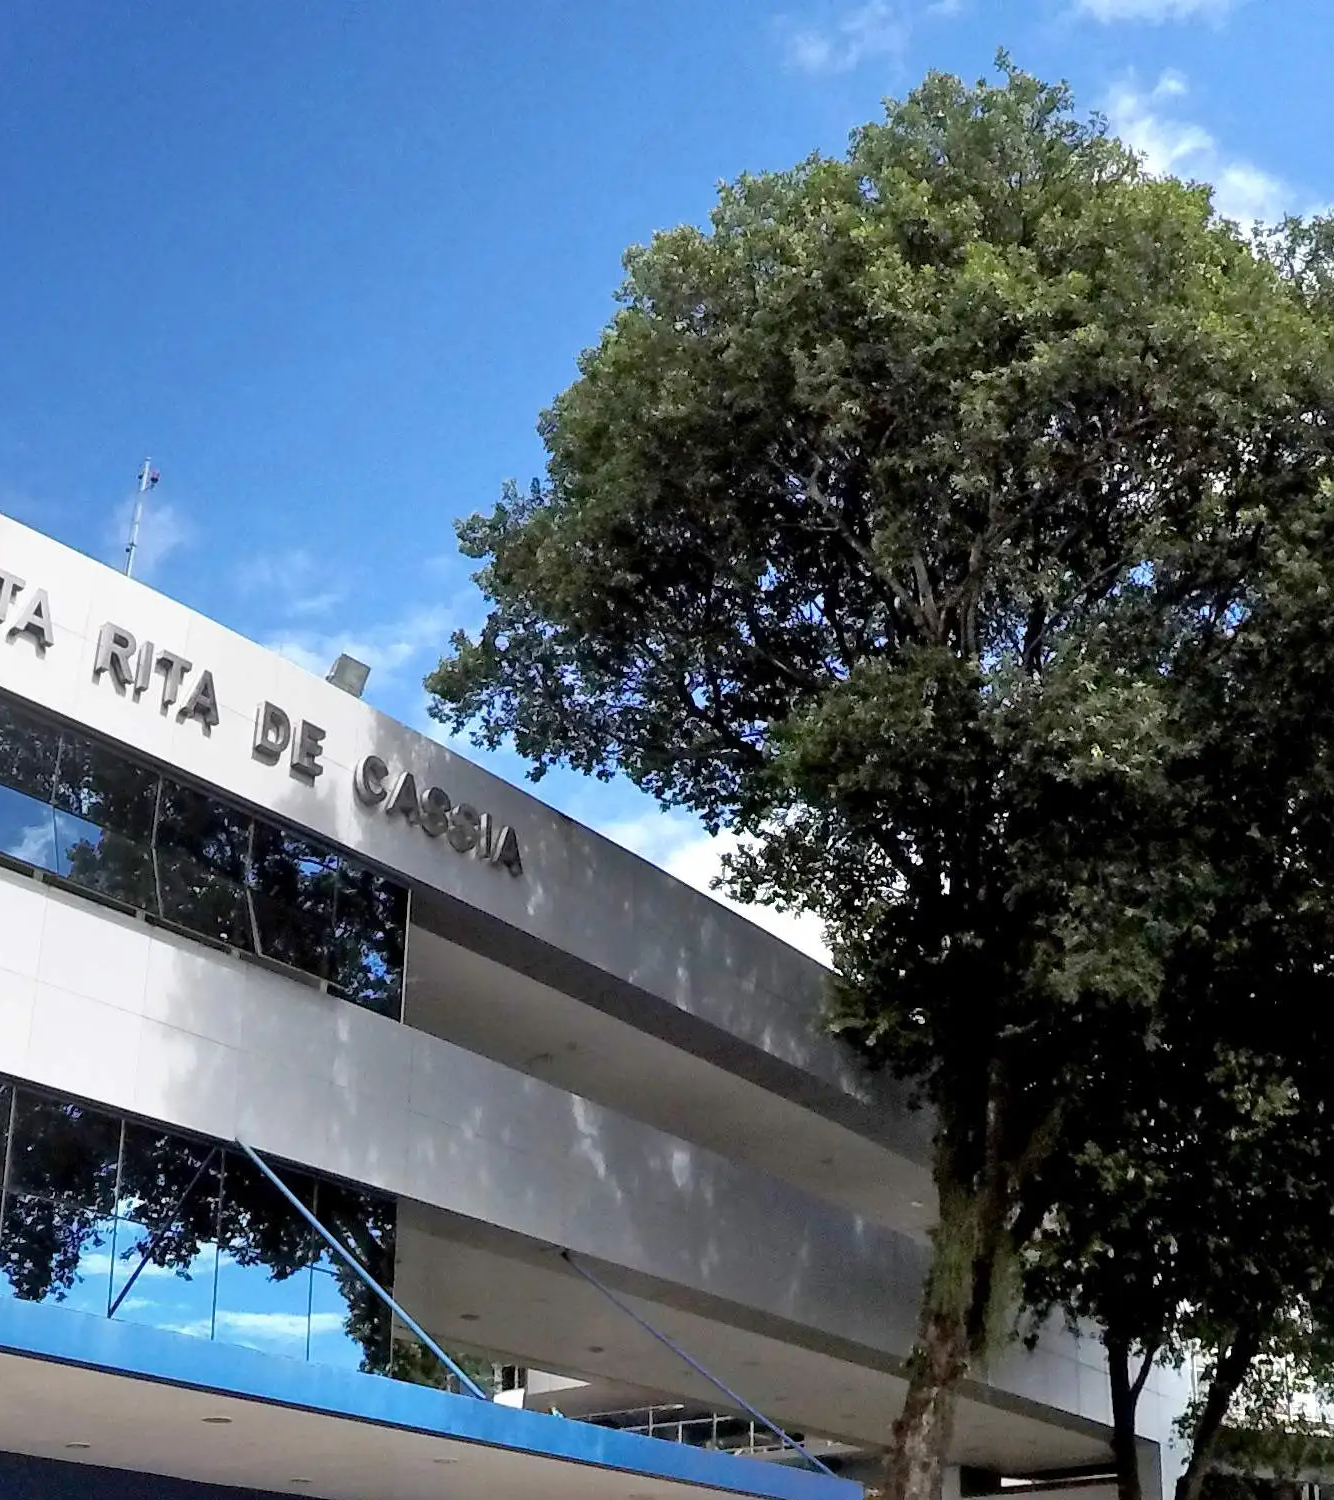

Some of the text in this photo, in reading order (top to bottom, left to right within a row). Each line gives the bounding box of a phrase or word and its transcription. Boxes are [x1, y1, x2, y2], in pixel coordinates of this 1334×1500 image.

[94, 622, 219, 737] RITA
[252, 701, 327, 785] DE
[354, 755, 523, 877] CASSIA
